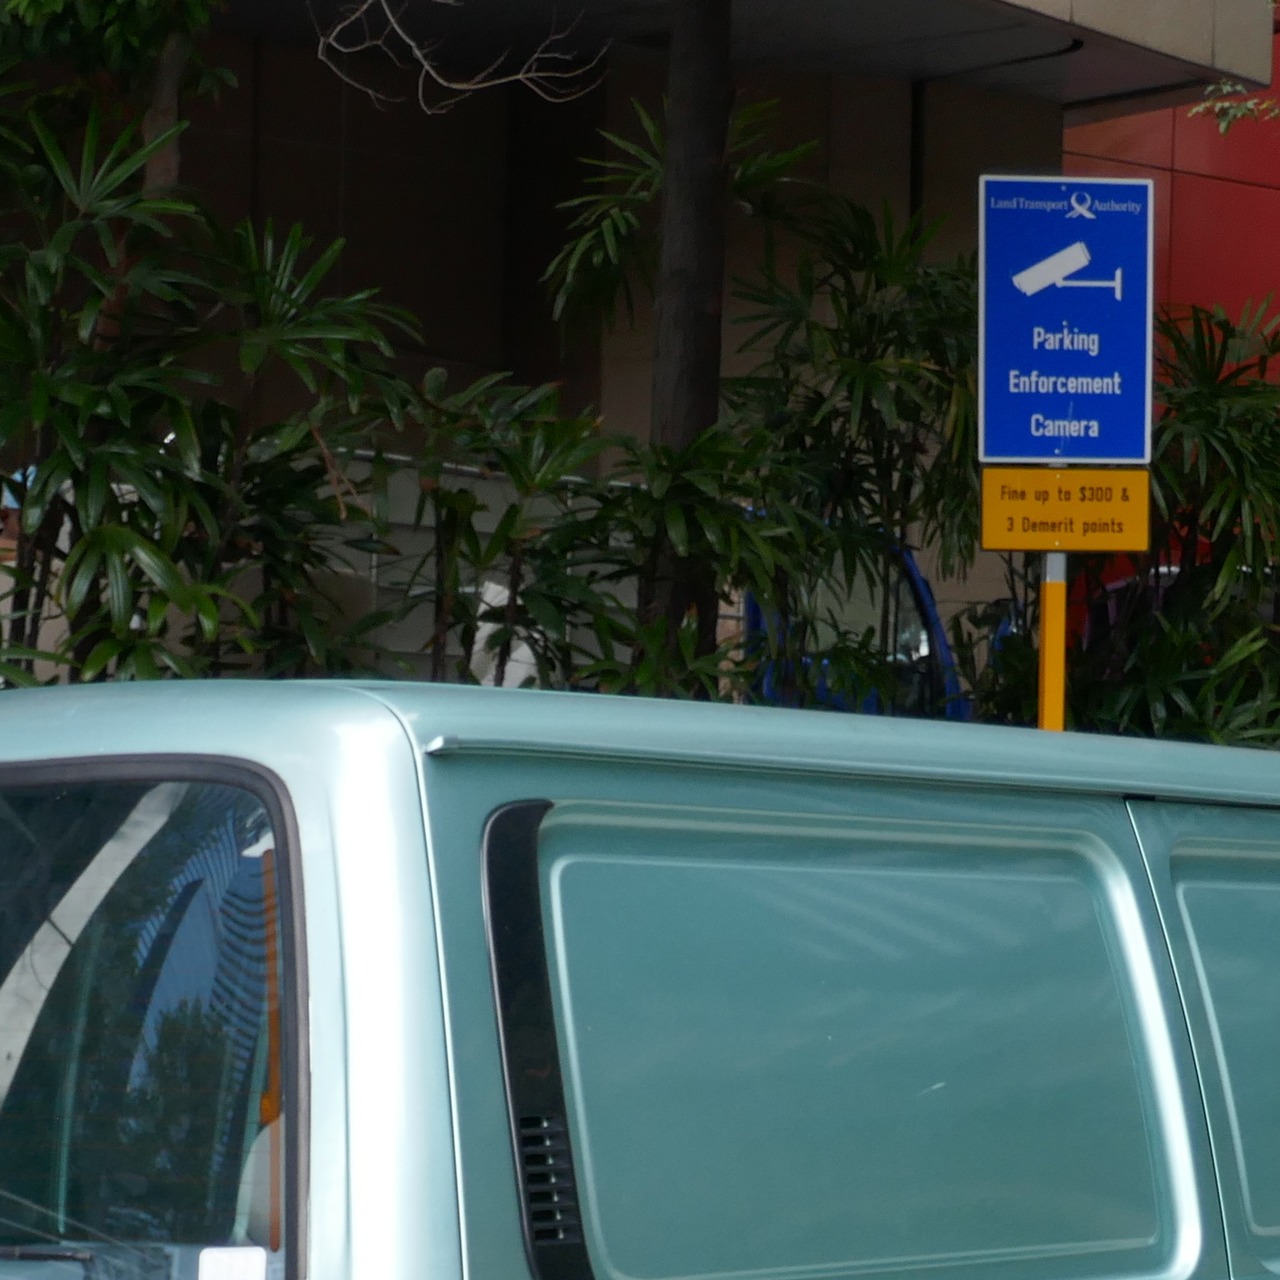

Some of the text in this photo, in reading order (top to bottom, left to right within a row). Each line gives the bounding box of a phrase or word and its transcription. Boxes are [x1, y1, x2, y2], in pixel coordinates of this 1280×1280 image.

[990, 196, 1142, 215] Land Transport Authority
[1032, 326, 1100, 357] Parking
[1008, 370, 1122, 395] Enforcement
[1030, 414, 1100, 438] Camera
[1000, 485, 1131, 505] Fine up to $300 &
[1007, 516, 1124, 536] 3 Demerit points
